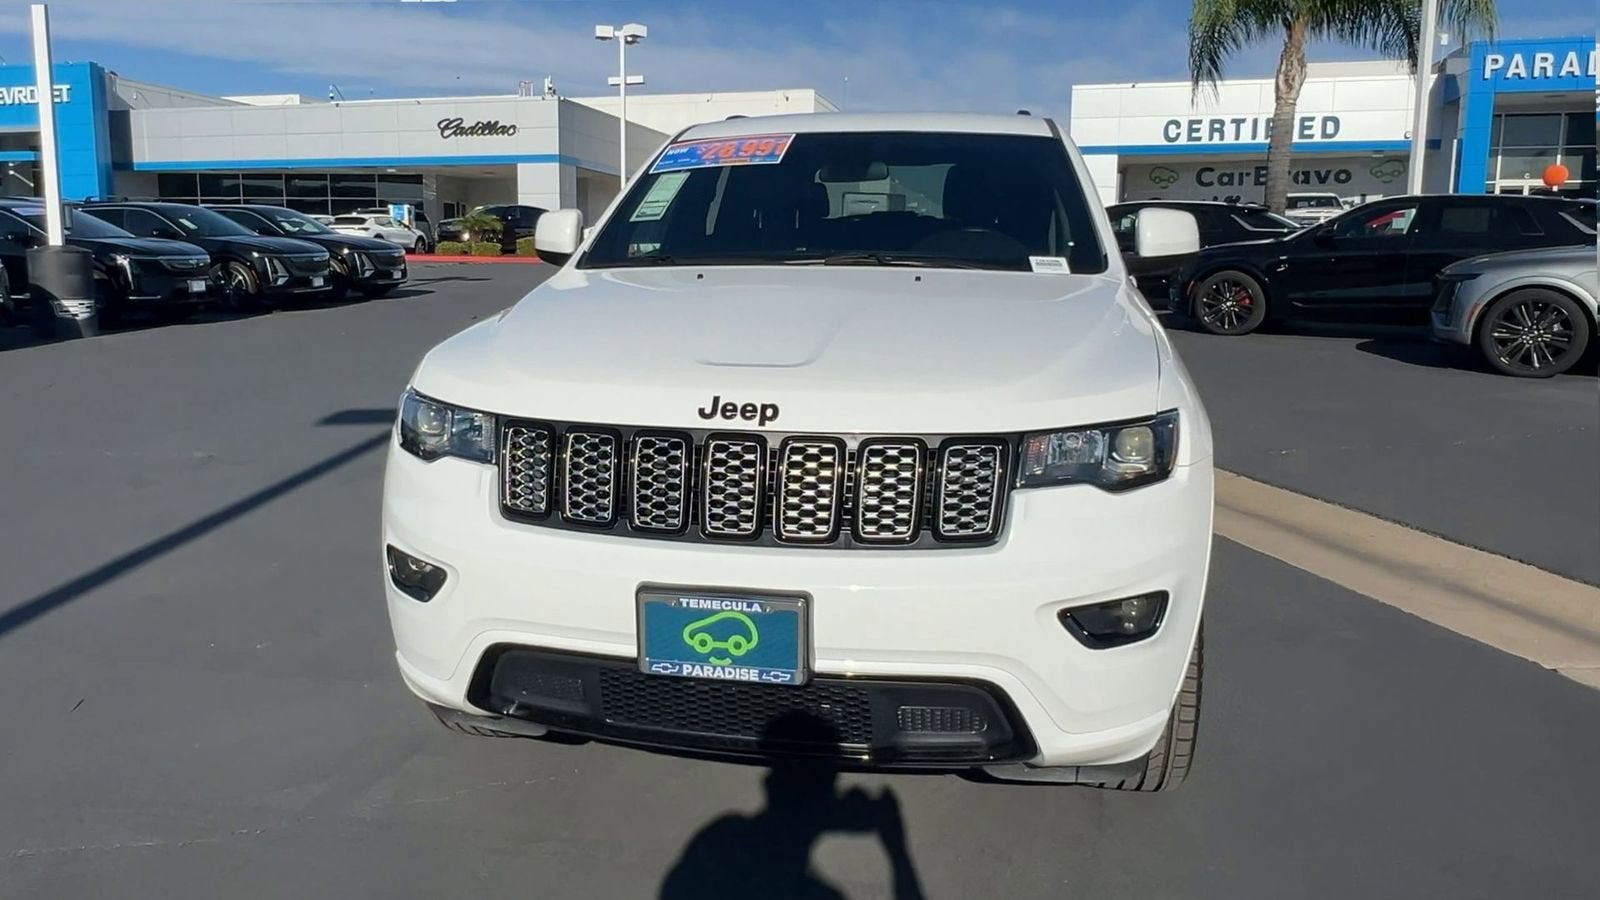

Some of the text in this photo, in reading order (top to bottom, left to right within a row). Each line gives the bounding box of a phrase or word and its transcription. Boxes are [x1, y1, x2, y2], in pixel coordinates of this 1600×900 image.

[0, 84, 71, 105] EVROET
[437, 117, 517, 139] Cadillac
[1163, 116, 1341, 142] CERTIFED
[1195, 166, 1353, 187] CarBavo
[698, 395, 779, 426] Jeep
[679, 598, 762, 612] TEMECULA
[682, 664, 760, 681] PARADISE
